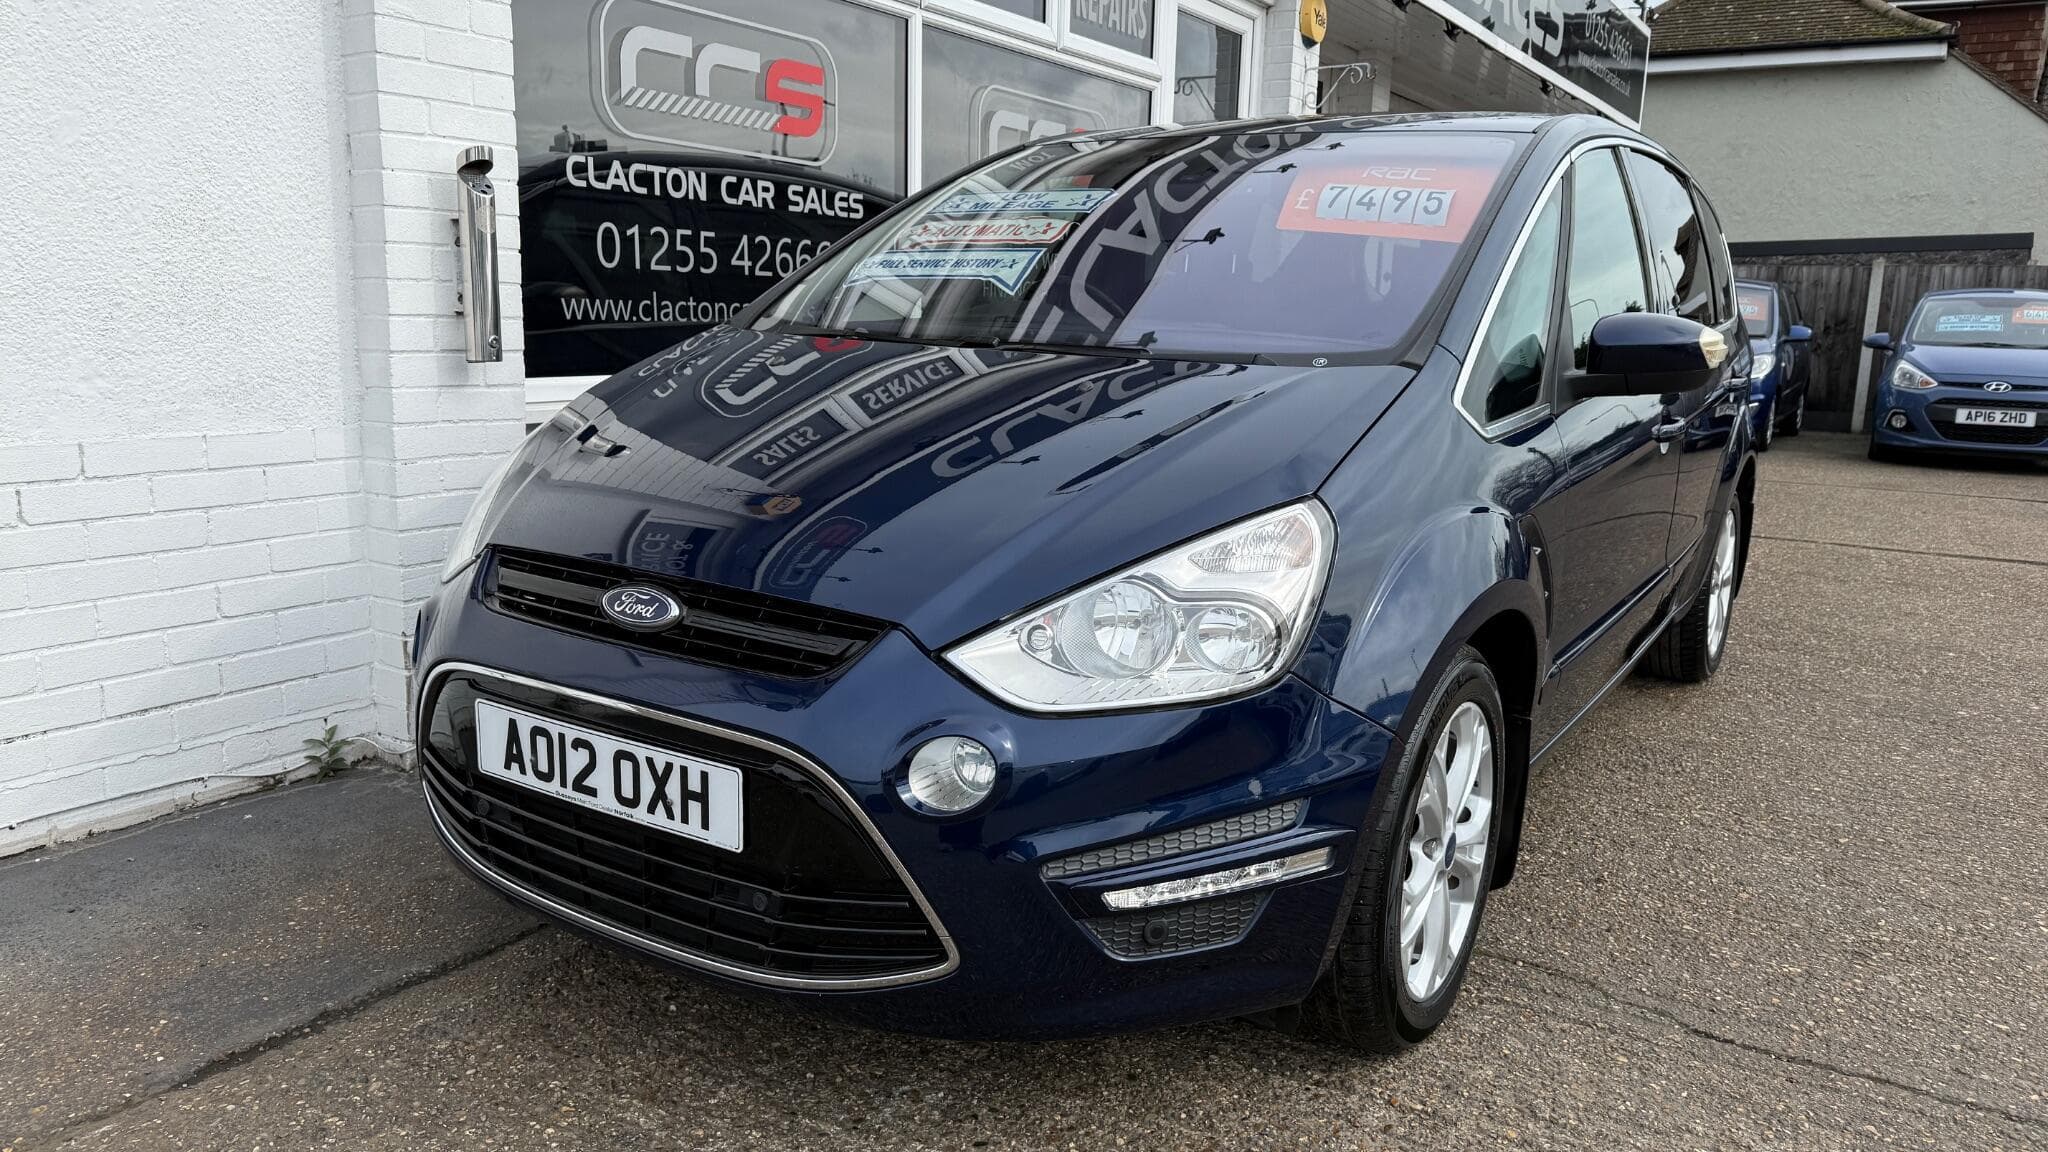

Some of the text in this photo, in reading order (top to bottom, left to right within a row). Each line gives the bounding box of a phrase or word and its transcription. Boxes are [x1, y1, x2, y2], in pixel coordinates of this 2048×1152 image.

[1585, 8, 1609, 51] 01255
[566, 155, 864, 219] CLACTON CAR SALES
[1001, 192, 1048, 201] LOW
[968, 200, 1058, 210] MILEAGE
[1294, 185, 1448, 216] £ 7495
[935, 223, 1031, 237] AUTOMATIC
[596, 222, 718, 274] 01255
[878, 258, 1001, 269] FULL SERVICE HISTORY
[1965, 410, 2028, 424] AP16 ZHD
[614, 591, 660, 618] Ford
[504, 717, 710, 832] AO12 OXH
[614, 808, 634, 818] Norfolk
